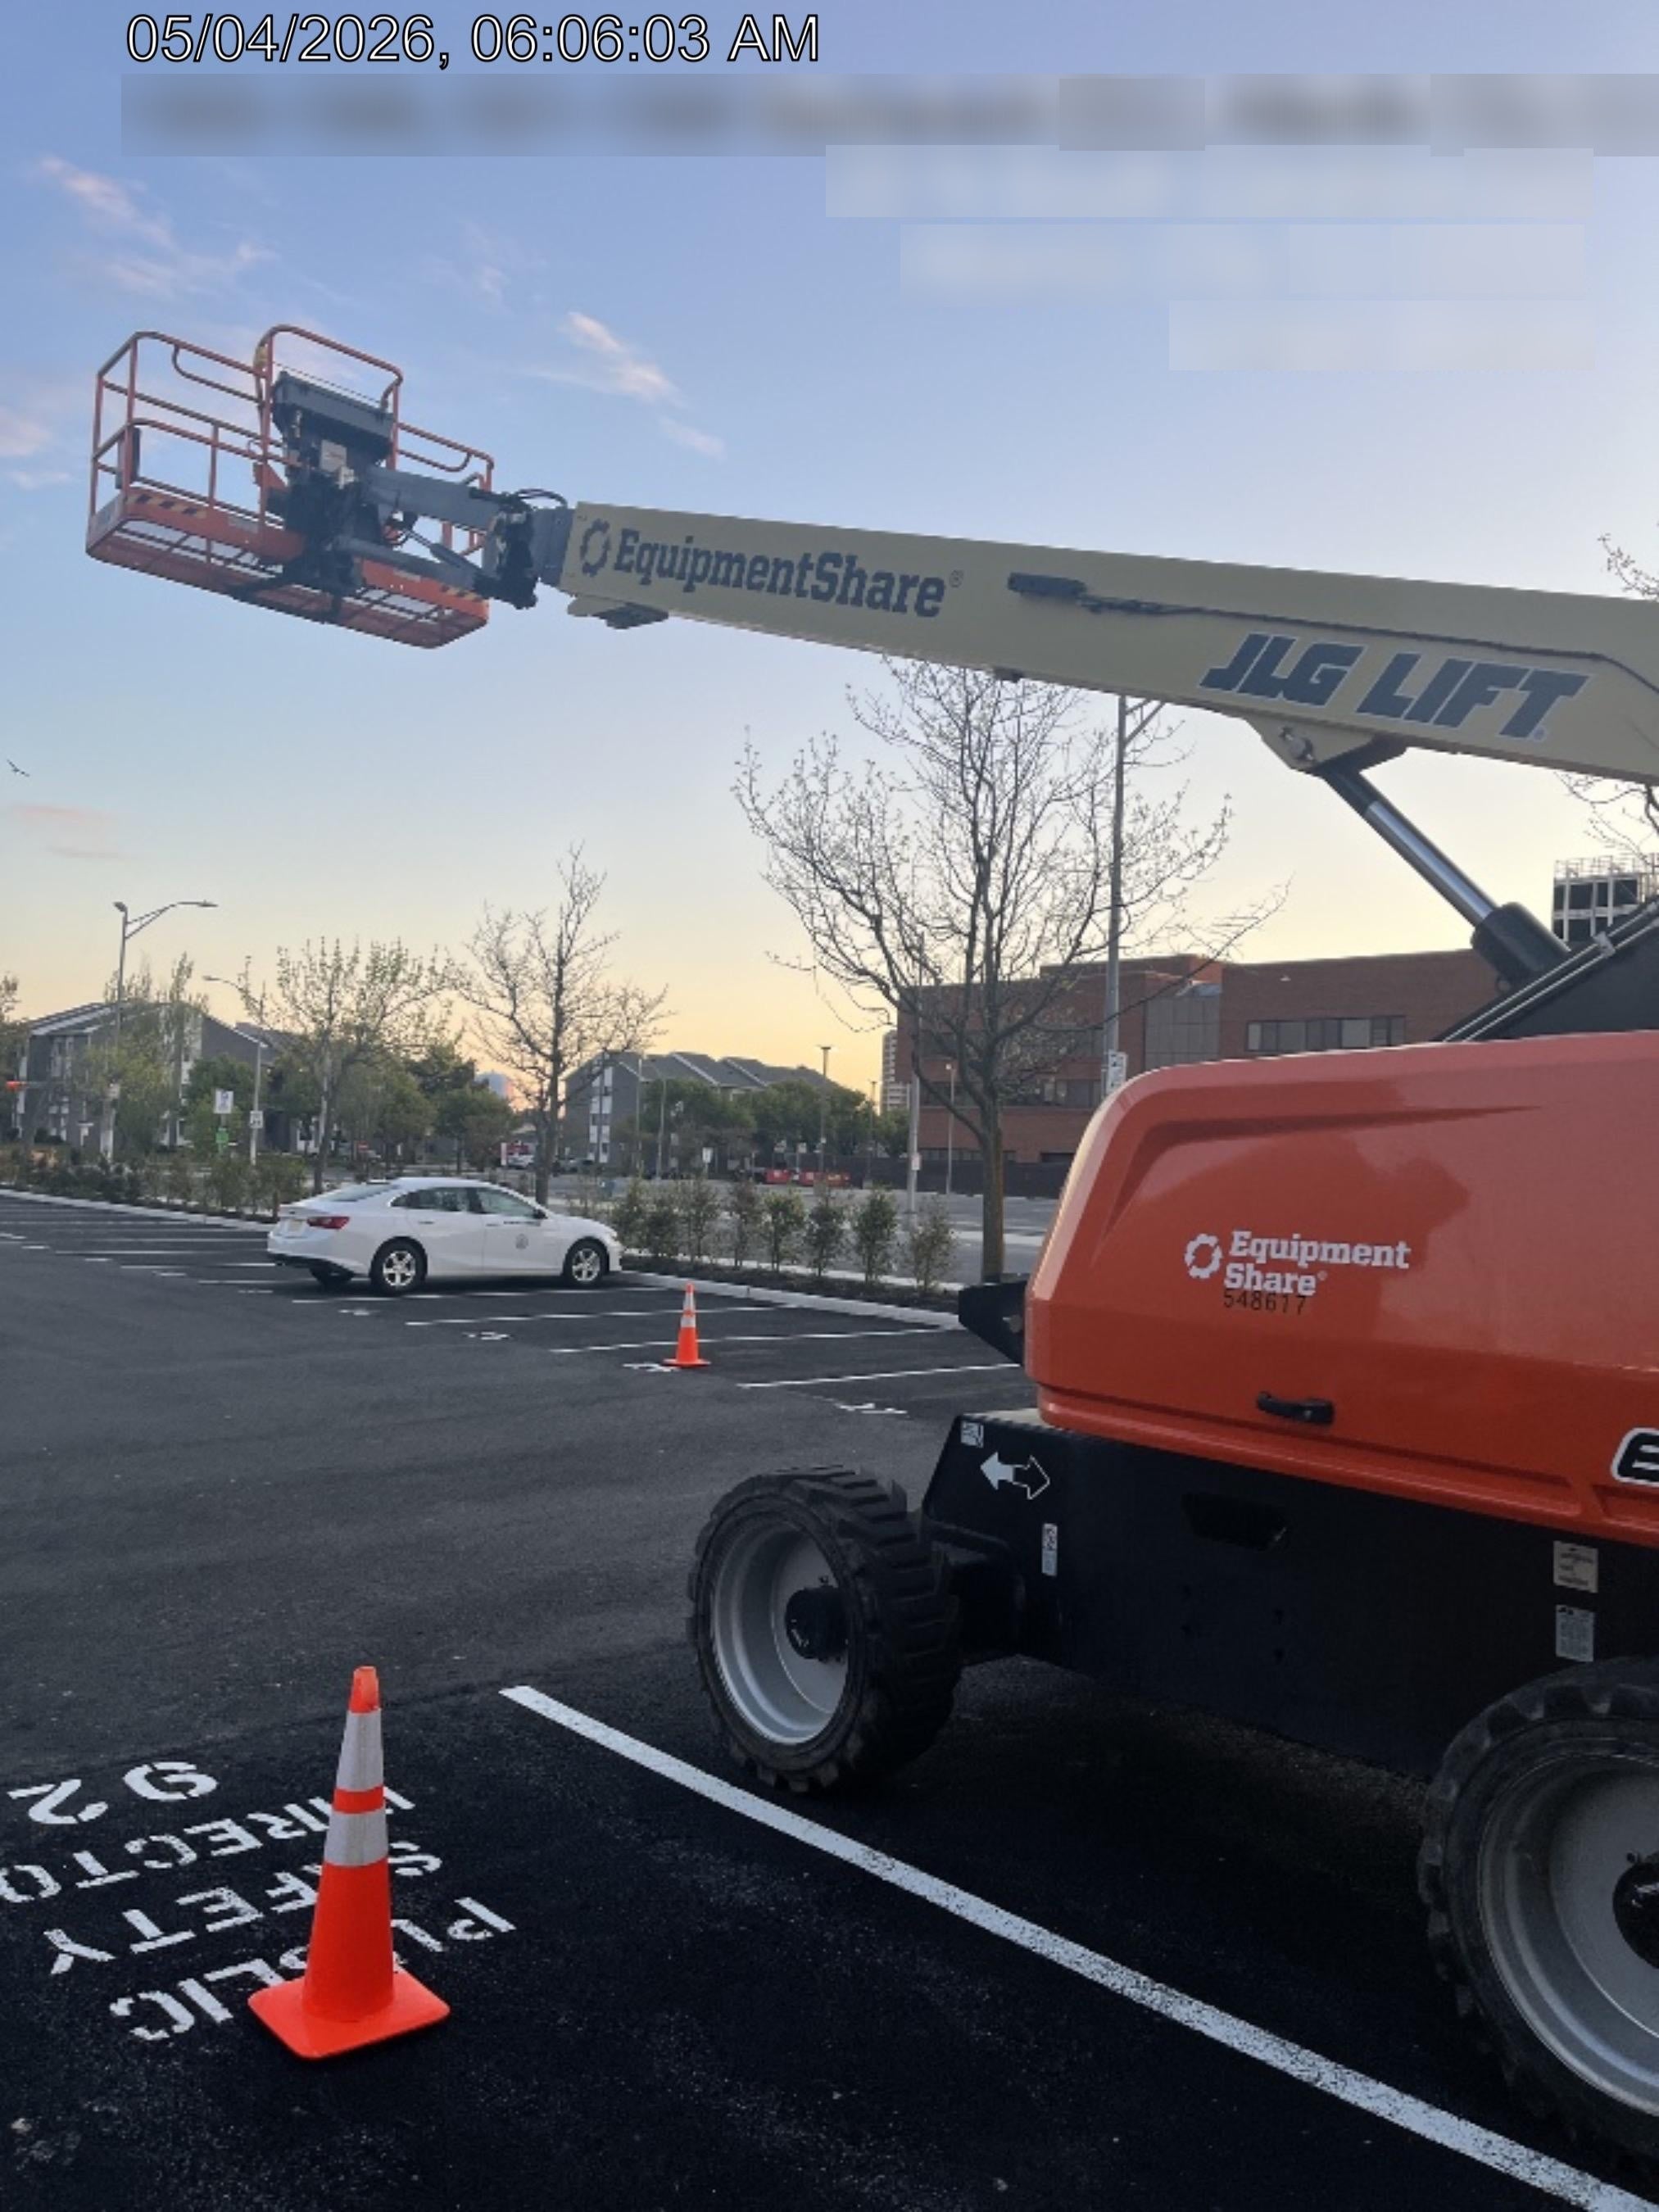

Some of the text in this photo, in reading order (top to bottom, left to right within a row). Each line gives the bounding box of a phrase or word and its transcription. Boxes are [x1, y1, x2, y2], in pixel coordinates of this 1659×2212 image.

[613, 528, 945, 618] EquipmentShare
[1199, 632, 1591, 739] JLG LIFT
[1224, 1262, 1317, 1296] Share
[1229, 1230, 1412, 1269] Equipment
[43, 1841, 443, 1975] SFETY
